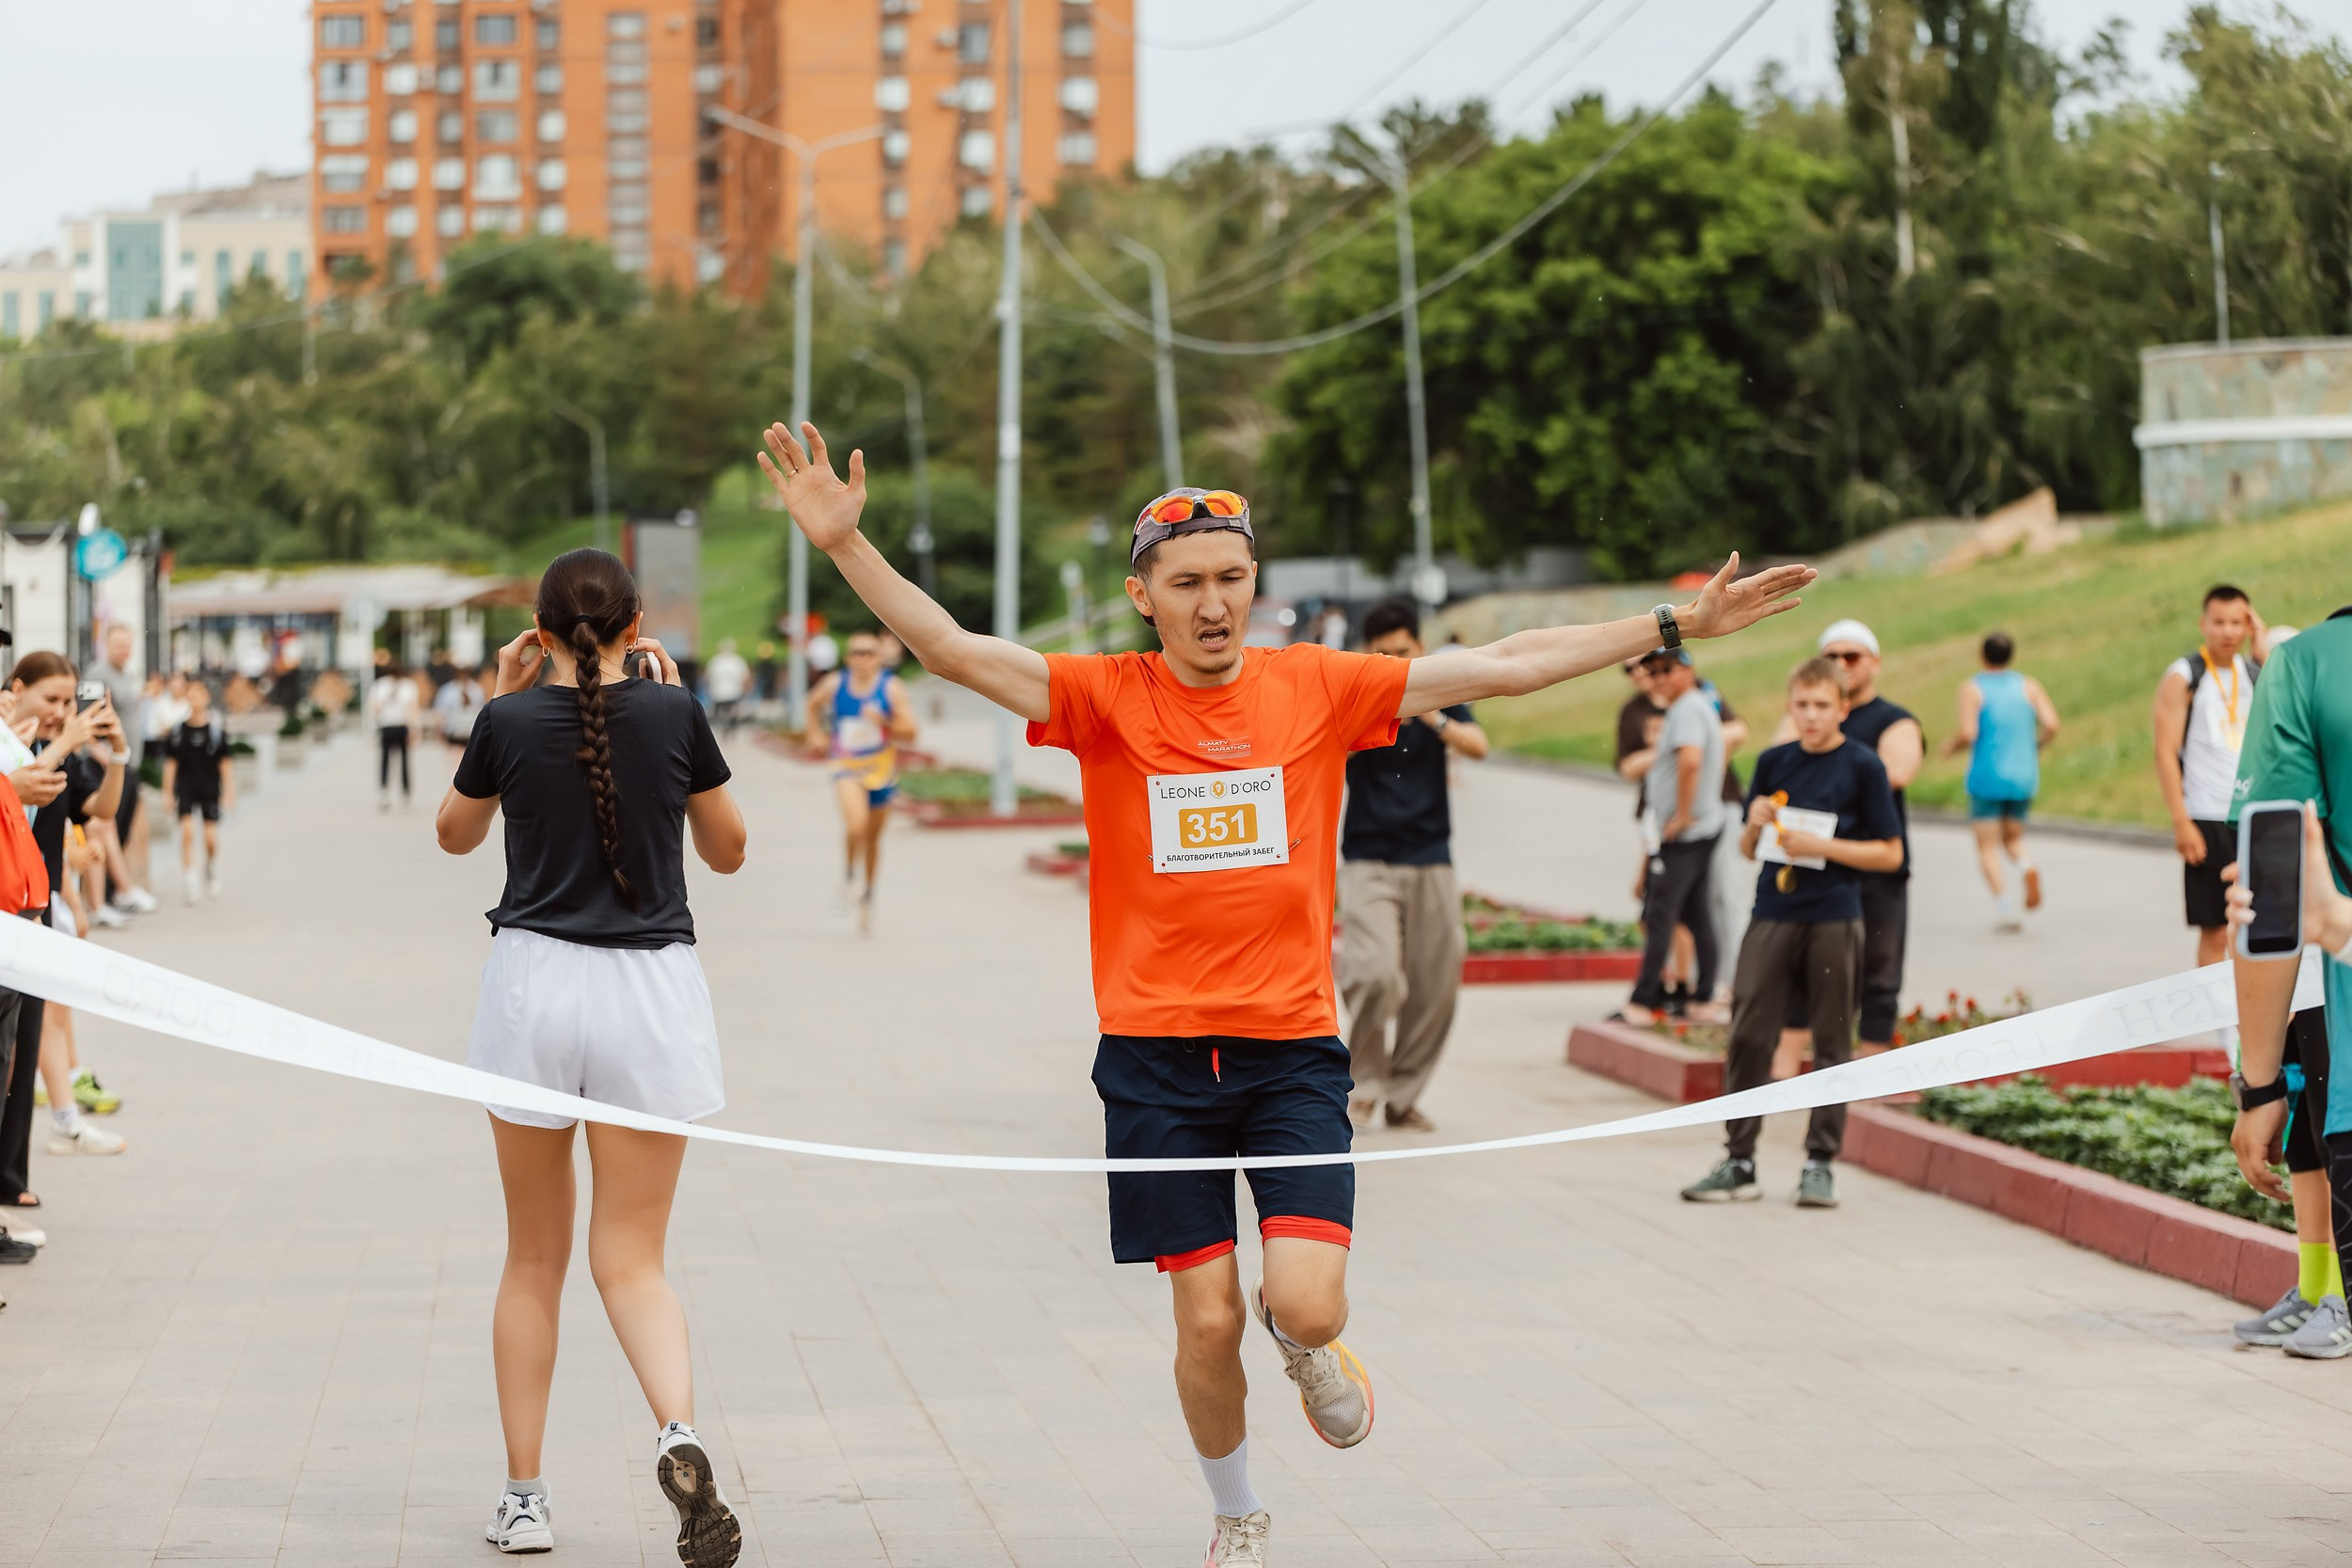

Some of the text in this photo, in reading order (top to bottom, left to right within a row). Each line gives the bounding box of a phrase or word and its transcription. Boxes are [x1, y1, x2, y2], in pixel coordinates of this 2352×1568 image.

[1207, 743, 1251, 752] MARATHON
[1160, 780, 1271, 800] LEONE D'ORO
[1186, 809, 1246, 844] 351
[1167, 847, 1275, 862] БЛАГОТВОРИТЕЛЬНЫЙ ЗАБЕГ
